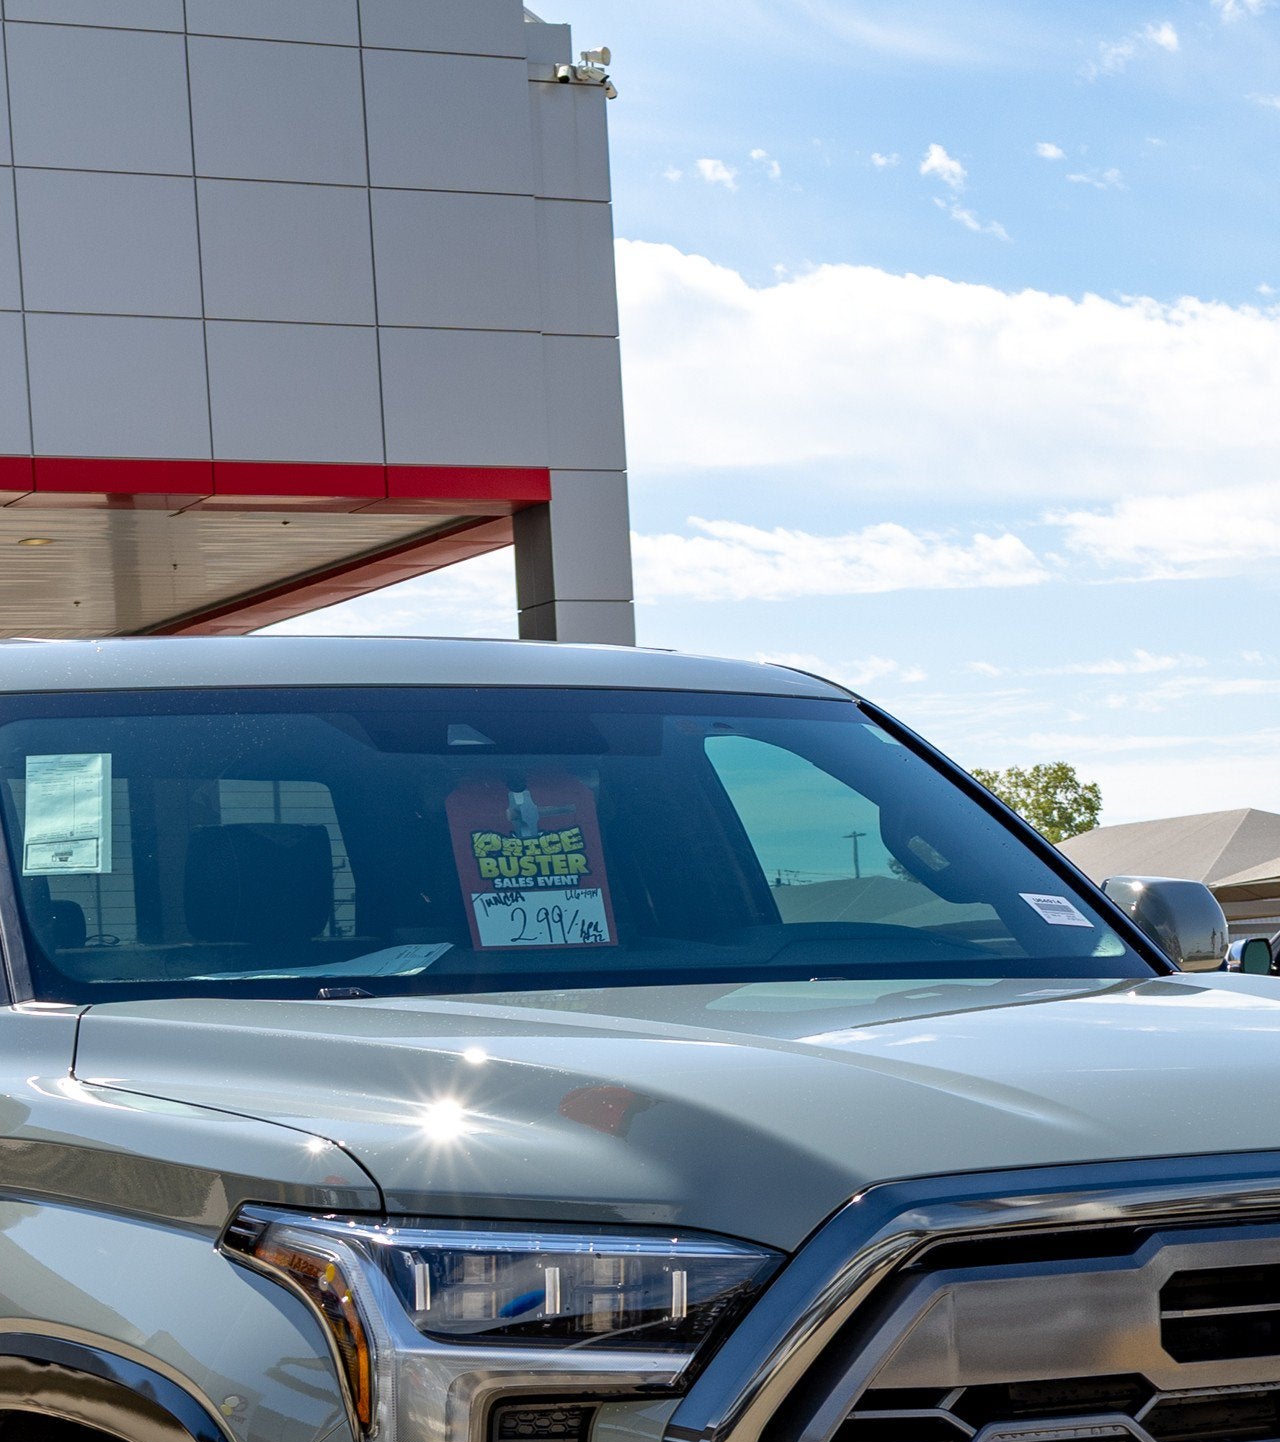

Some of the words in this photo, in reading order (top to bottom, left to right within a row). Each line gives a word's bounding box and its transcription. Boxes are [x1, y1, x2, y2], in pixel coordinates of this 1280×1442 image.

[472, 827, 584, 857] PRICE
[479, 853, 589, 878] BUSTER
[494, 878, 534, 889] SALES
[538, 875, 579, 887] EVENT
